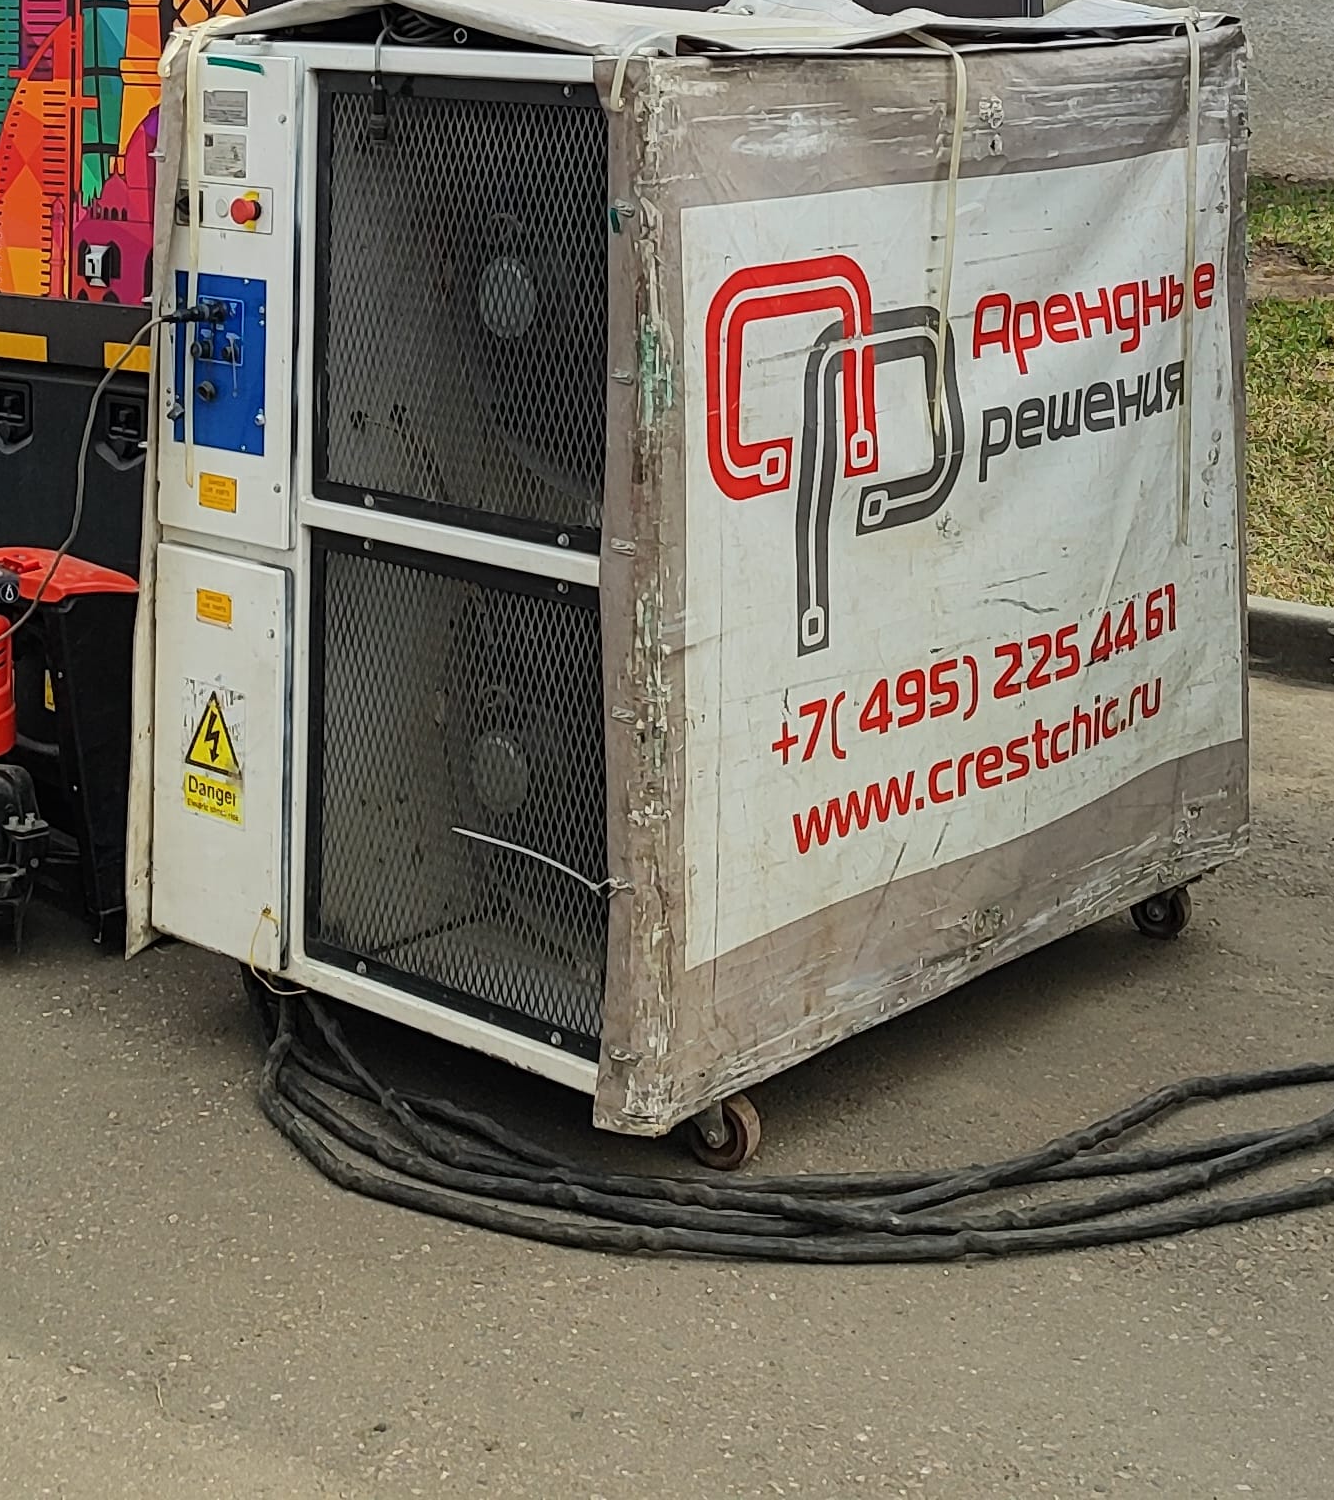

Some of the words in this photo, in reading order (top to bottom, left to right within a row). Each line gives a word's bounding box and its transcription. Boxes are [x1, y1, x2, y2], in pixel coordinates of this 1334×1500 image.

[979, 360, 1185, 482] решения
[993, 623, 1081, 700] 225
[793, 677, 1162, 854] www.crestchic.ru
